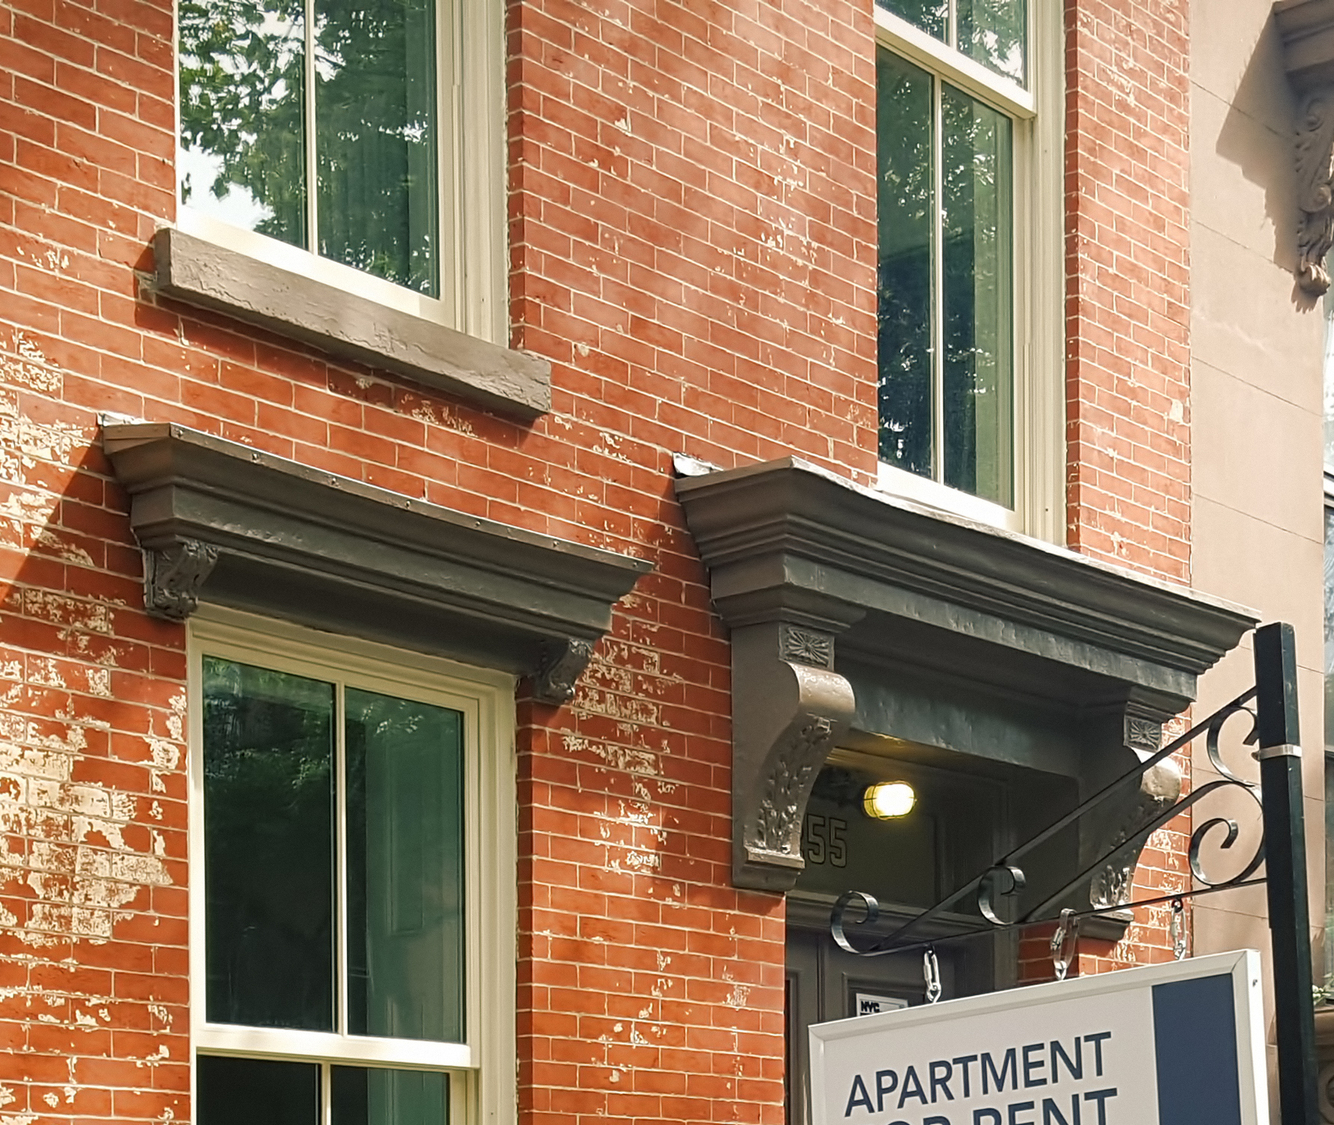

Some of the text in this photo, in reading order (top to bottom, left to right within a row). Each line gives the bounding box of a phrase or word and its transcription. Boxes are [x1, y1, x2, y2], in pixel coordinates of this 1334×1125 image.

[799, 813, 847, 868] 55
[861, 1001, 880, 1013] NYC
[844, 1031, 1112, 1117] APARTMENT
